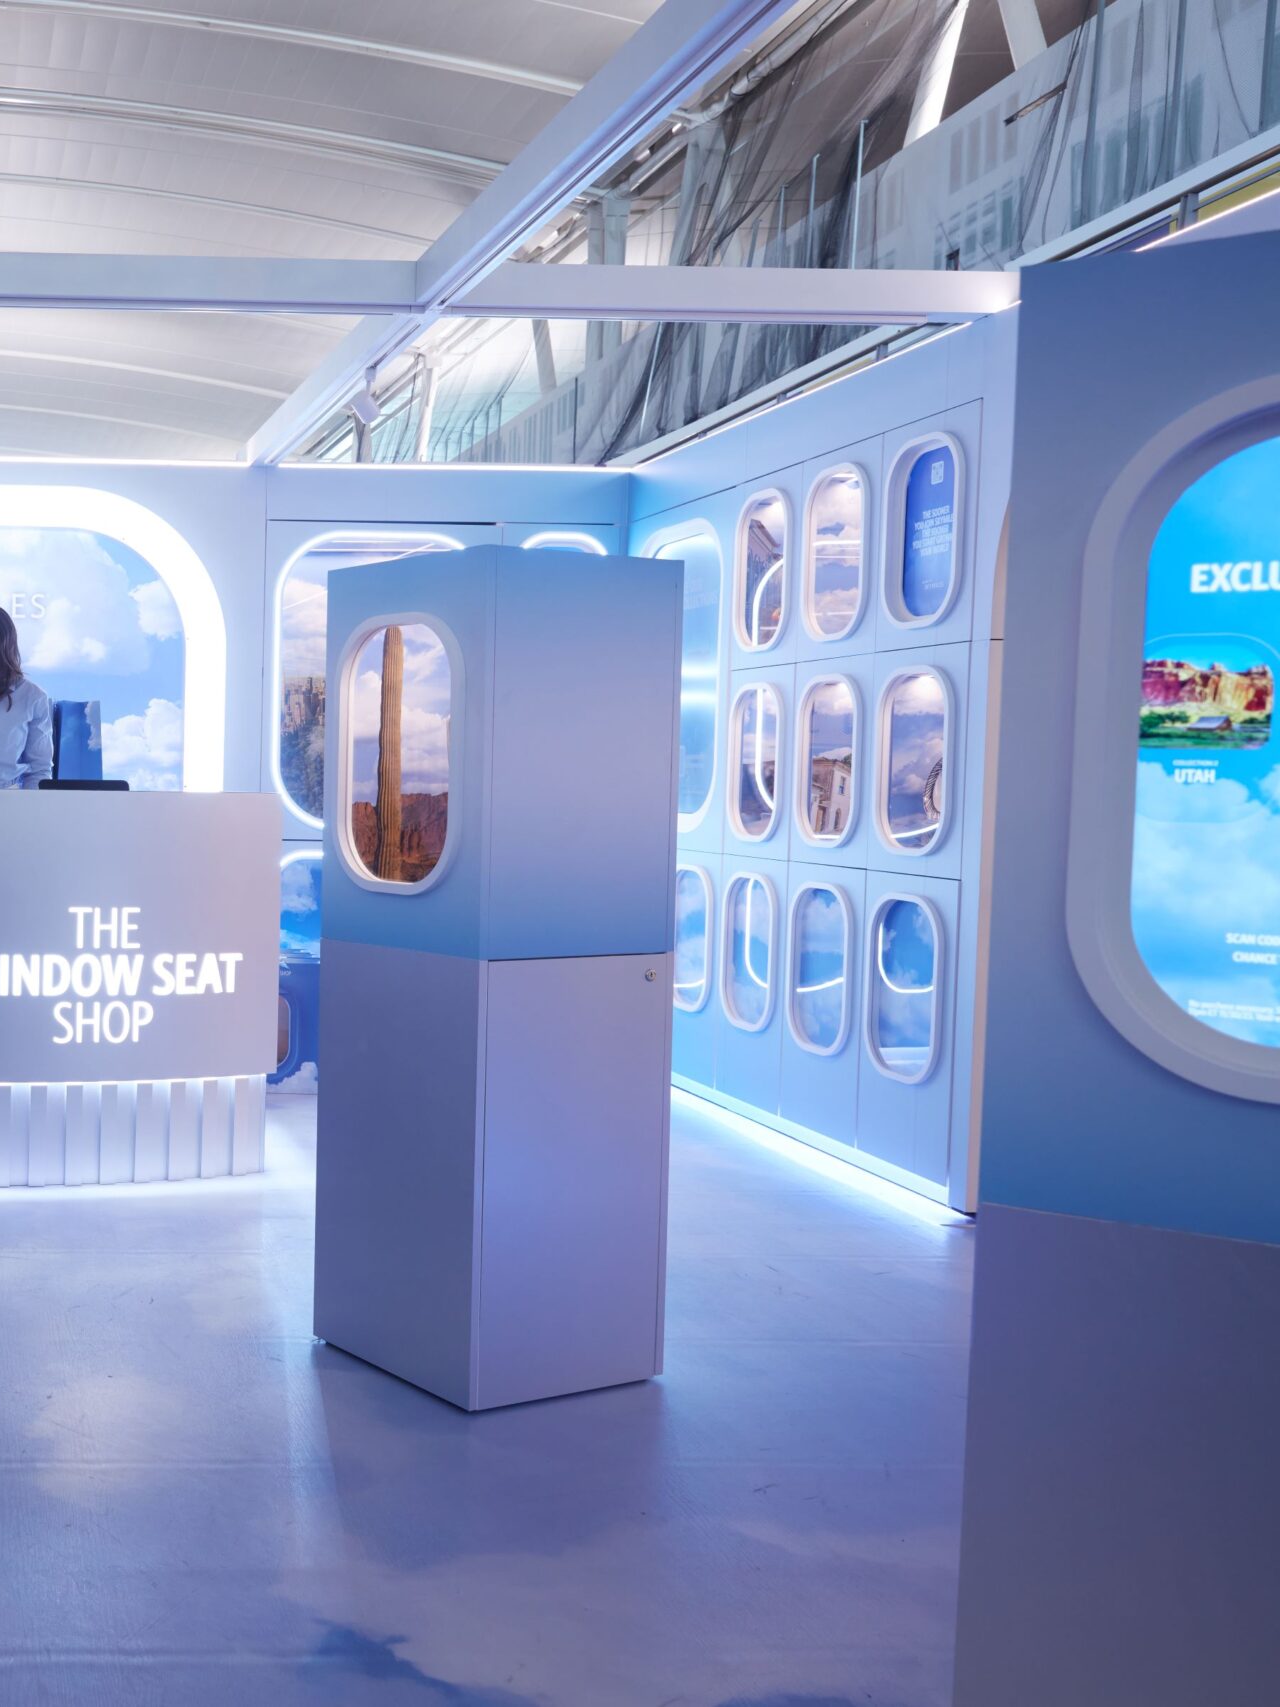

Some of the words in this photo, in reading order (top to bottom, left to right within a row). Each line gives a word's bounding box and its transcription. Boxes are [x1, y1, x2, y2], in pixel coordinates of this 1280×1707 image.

[1174, 768, 1217, 784] UTAH
[68, 906, 141, 949] THE
[1225, 932, 1257, 945] SCAN
[1232, 951, 1277, 965] CHANCE
[152, 952, 244, 996] SEAT
[52, 1001, 154, 1044] SHOP
